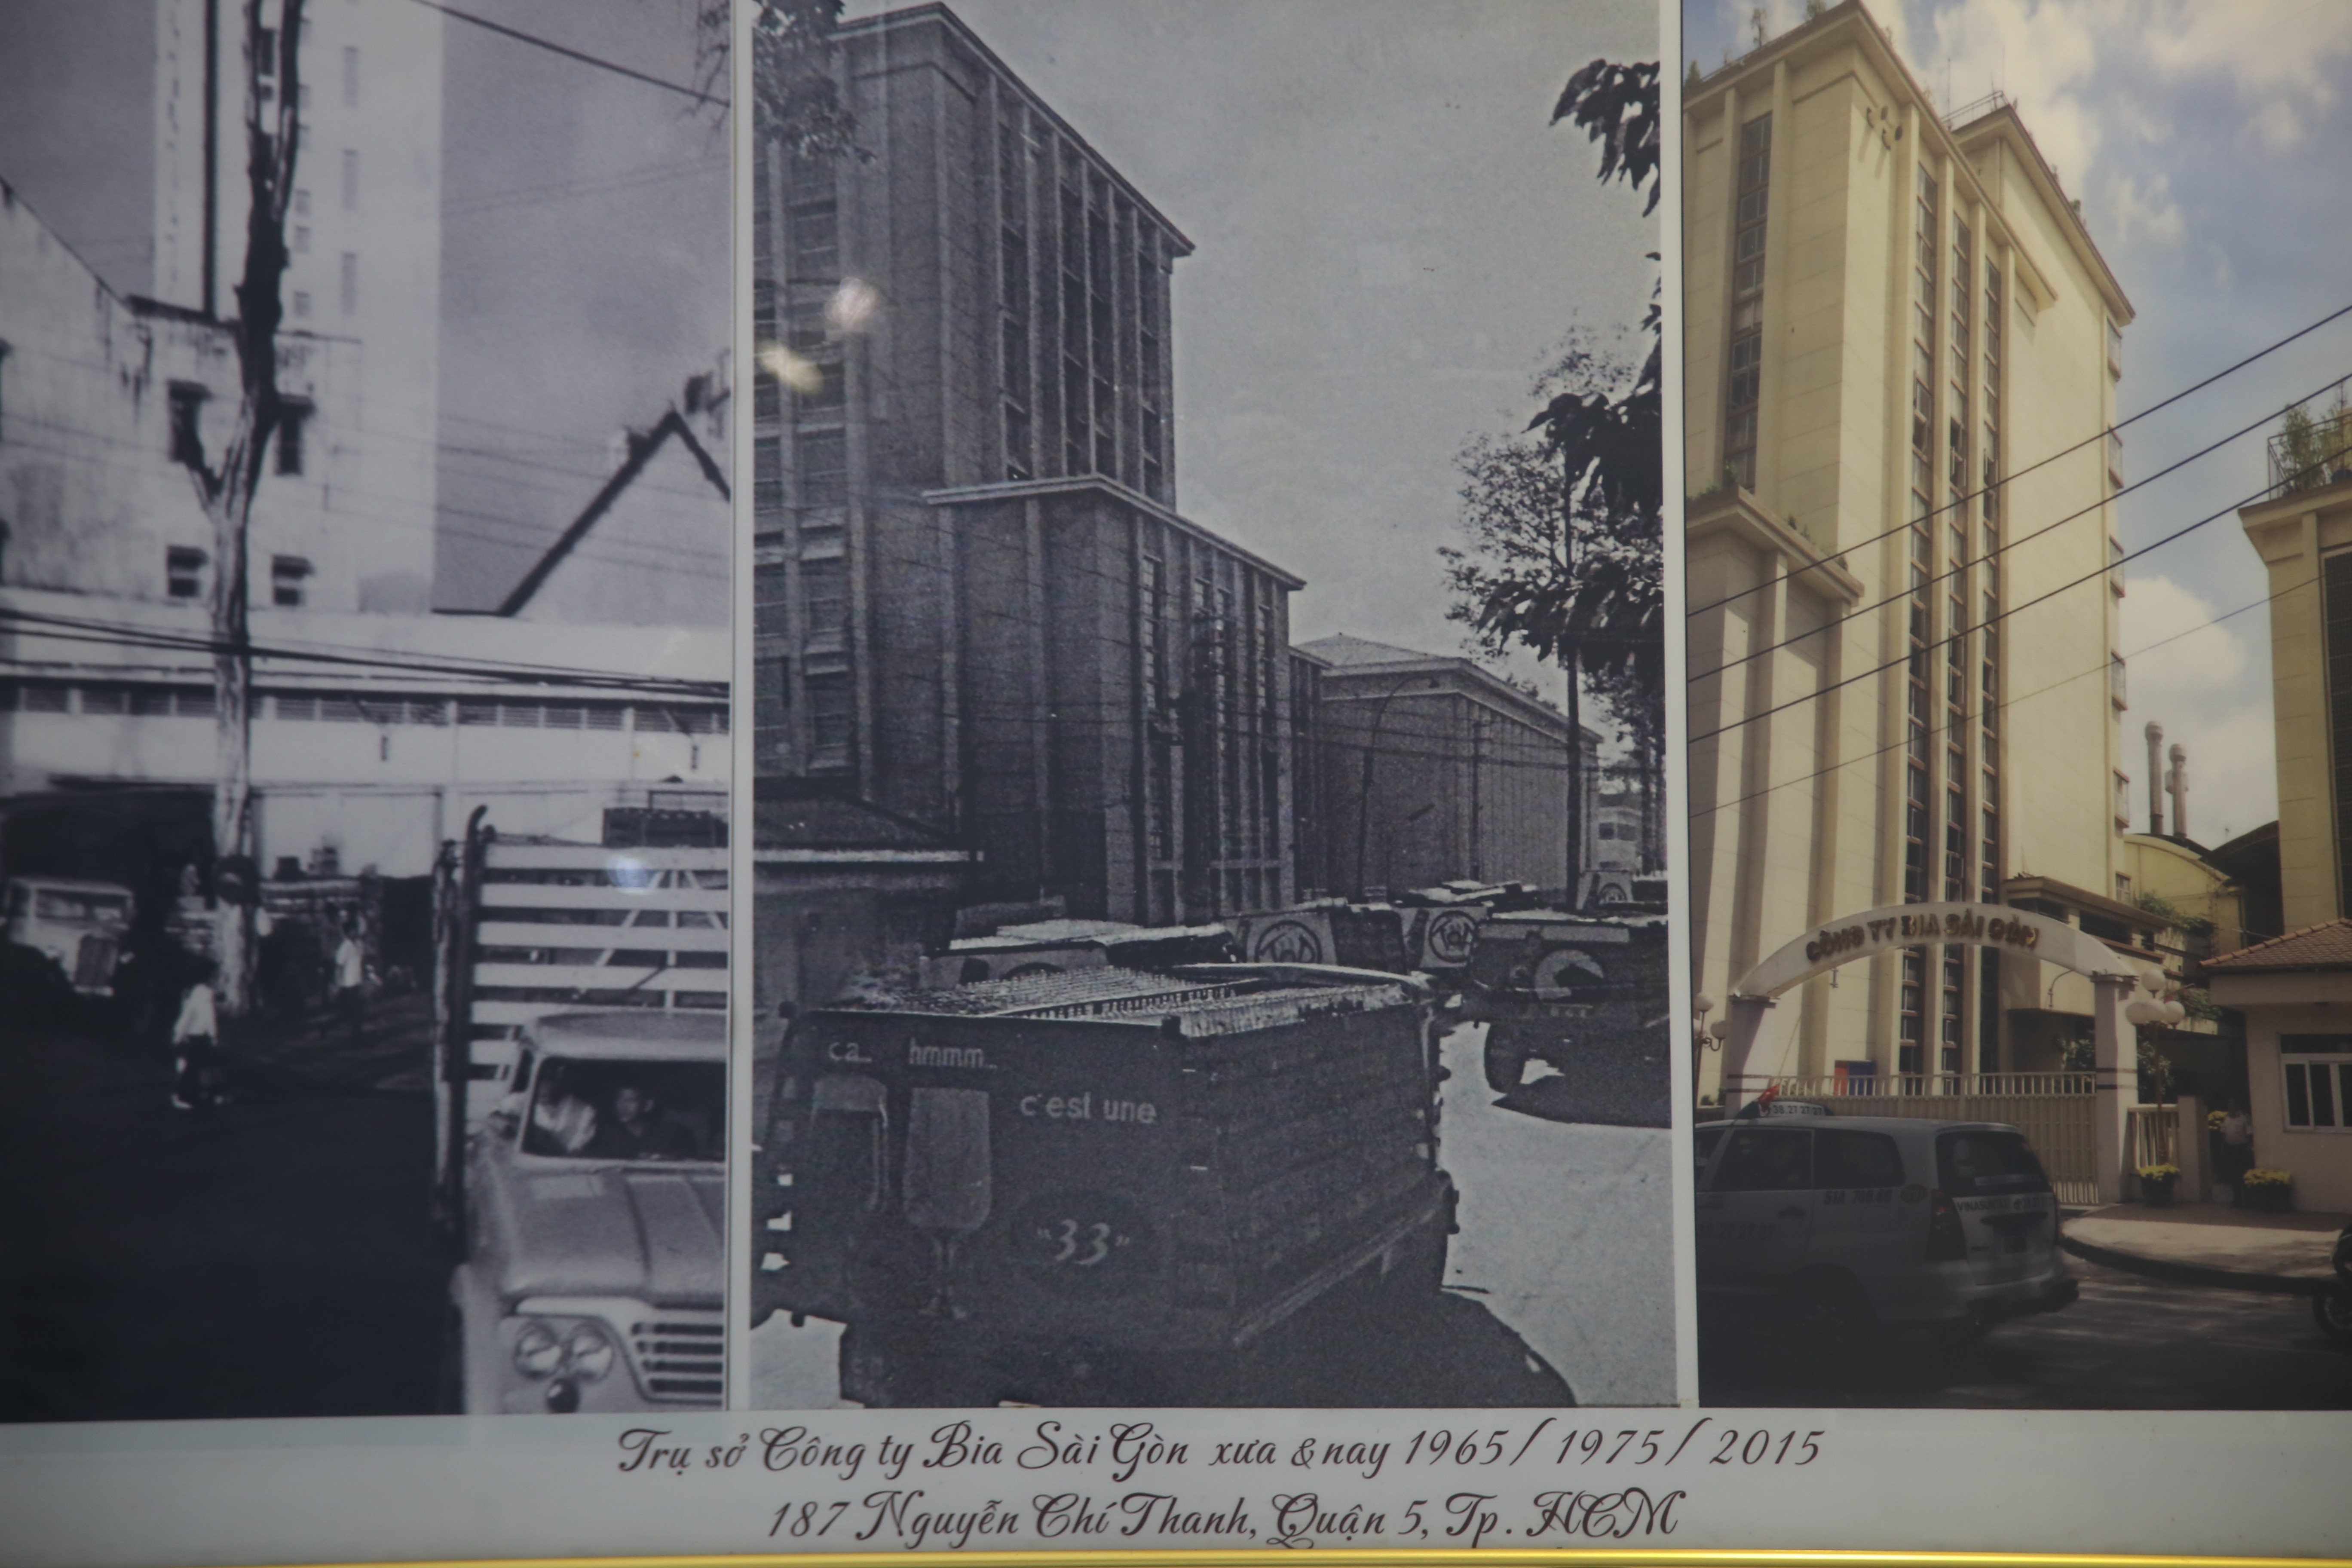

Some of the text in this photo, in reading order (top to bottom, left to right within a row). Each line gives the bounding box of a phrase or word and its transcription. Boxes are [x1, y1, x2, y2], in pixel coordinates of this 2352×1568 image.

[1103, 1099, 1158, 1124] une
[618, 1428, 691, 1476] Trụ
[705, 1433, 750, 1468] sở
[759, 1426, 866, 1481] Công
[878, 1435, 914, 1480] ty
[922, 1420, 1003, 1468] Bia
[1017, 1421, 1101, 1470] Sài
[1109, 1422, 1189, 1483] Gòn
[1208, 1439, 1276, 1466] xưa
[769, 1487, 1687, 1549] 187 Nguyễn Chí Thanh, Quận 5, Tp. HCM
